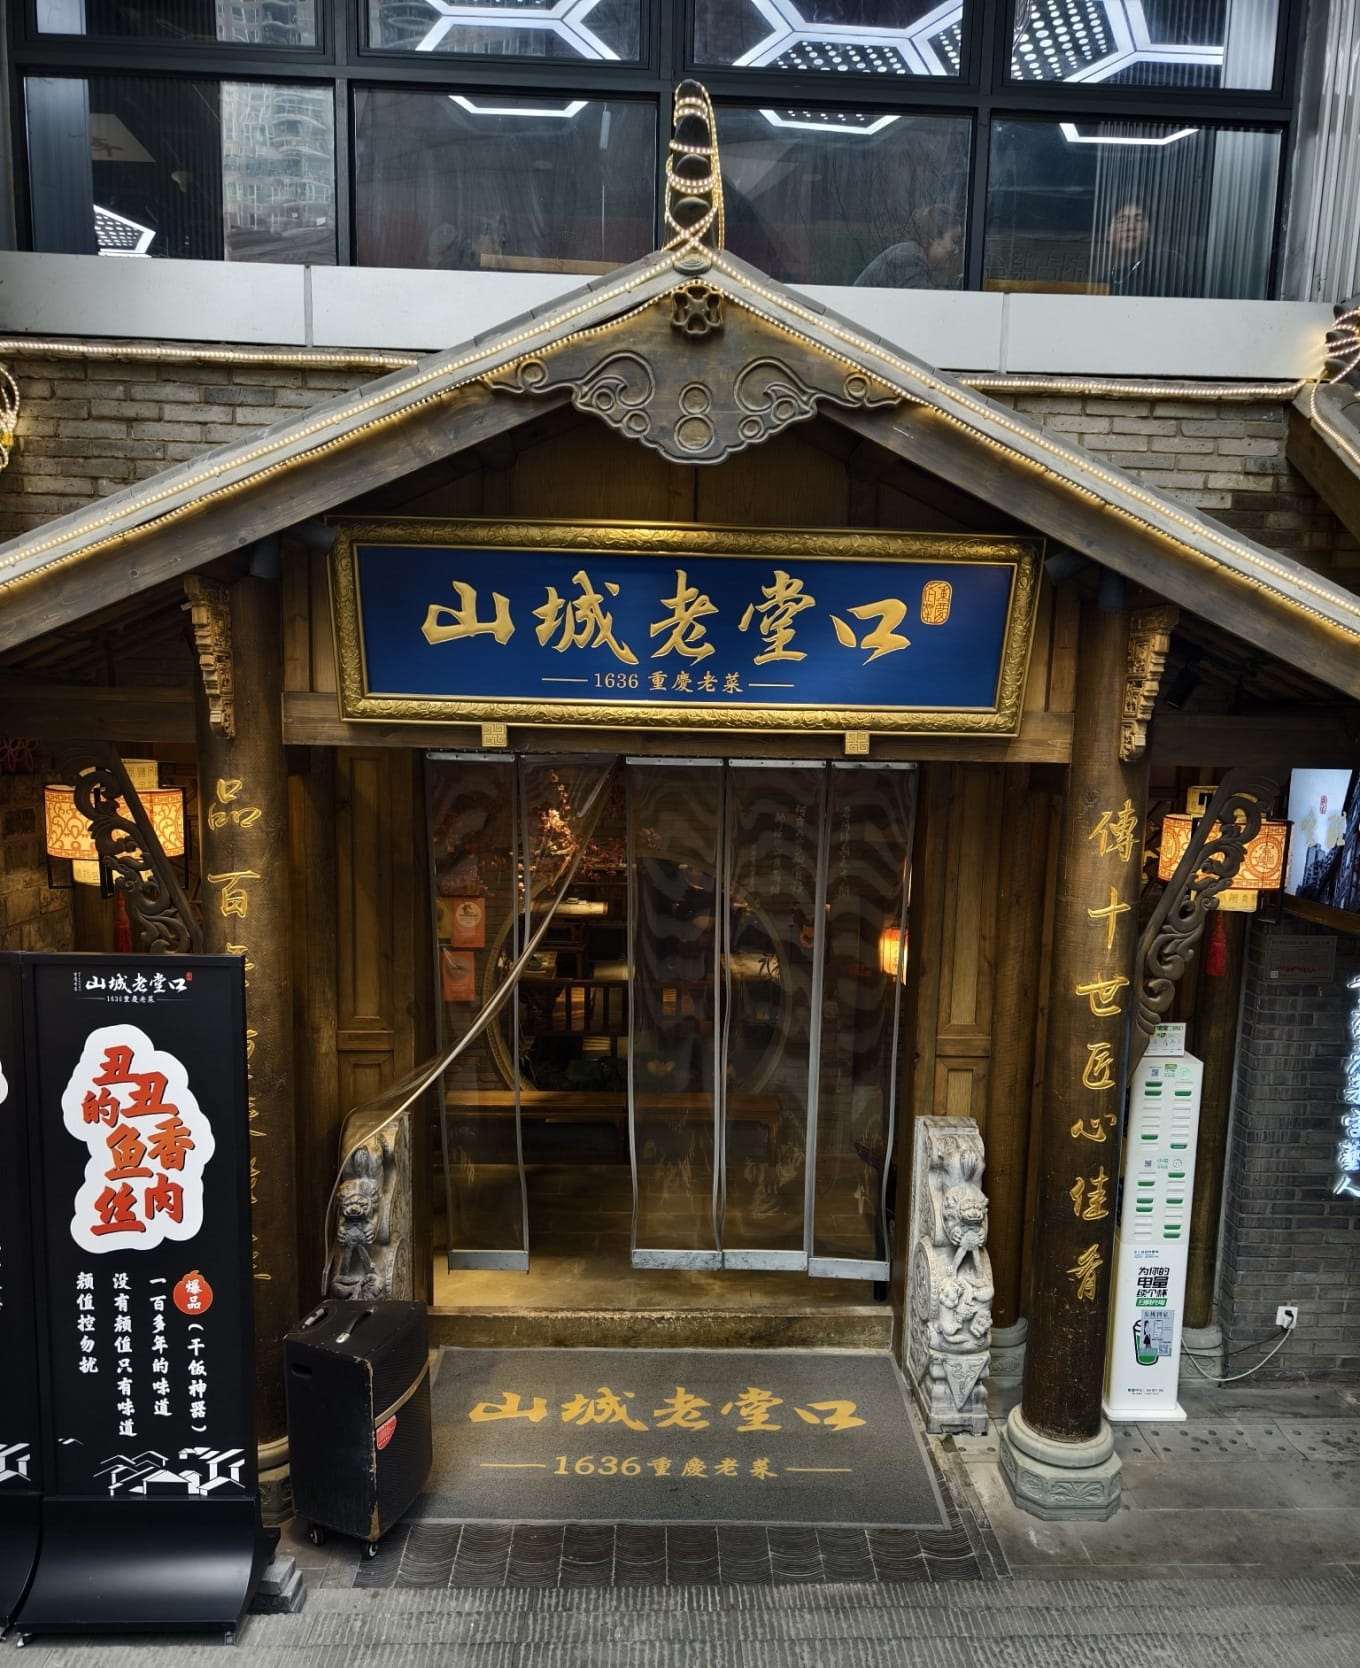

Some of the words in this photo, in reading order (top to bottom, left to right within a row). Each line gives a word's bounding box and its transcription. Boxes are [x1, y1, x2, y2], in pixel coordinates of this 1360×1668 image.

[421, 569, 911, 666] 山城老堂口
[593, 671, 639, 690] 1636
[85, 972, 188, 994] 山城老堂口
[185, 1279, 203, 1310] 爆品
[1137, 1276, 1169, 1288] 电量
[76, 1271, 99, 1374] 颜值控勿扰
[112, 1272, 137, 1437] 没有颜值只有味道
[149, 1277, 173, 1417] 一百多年的味道
[467, 1386, 867, 1432] 山城老堂口
